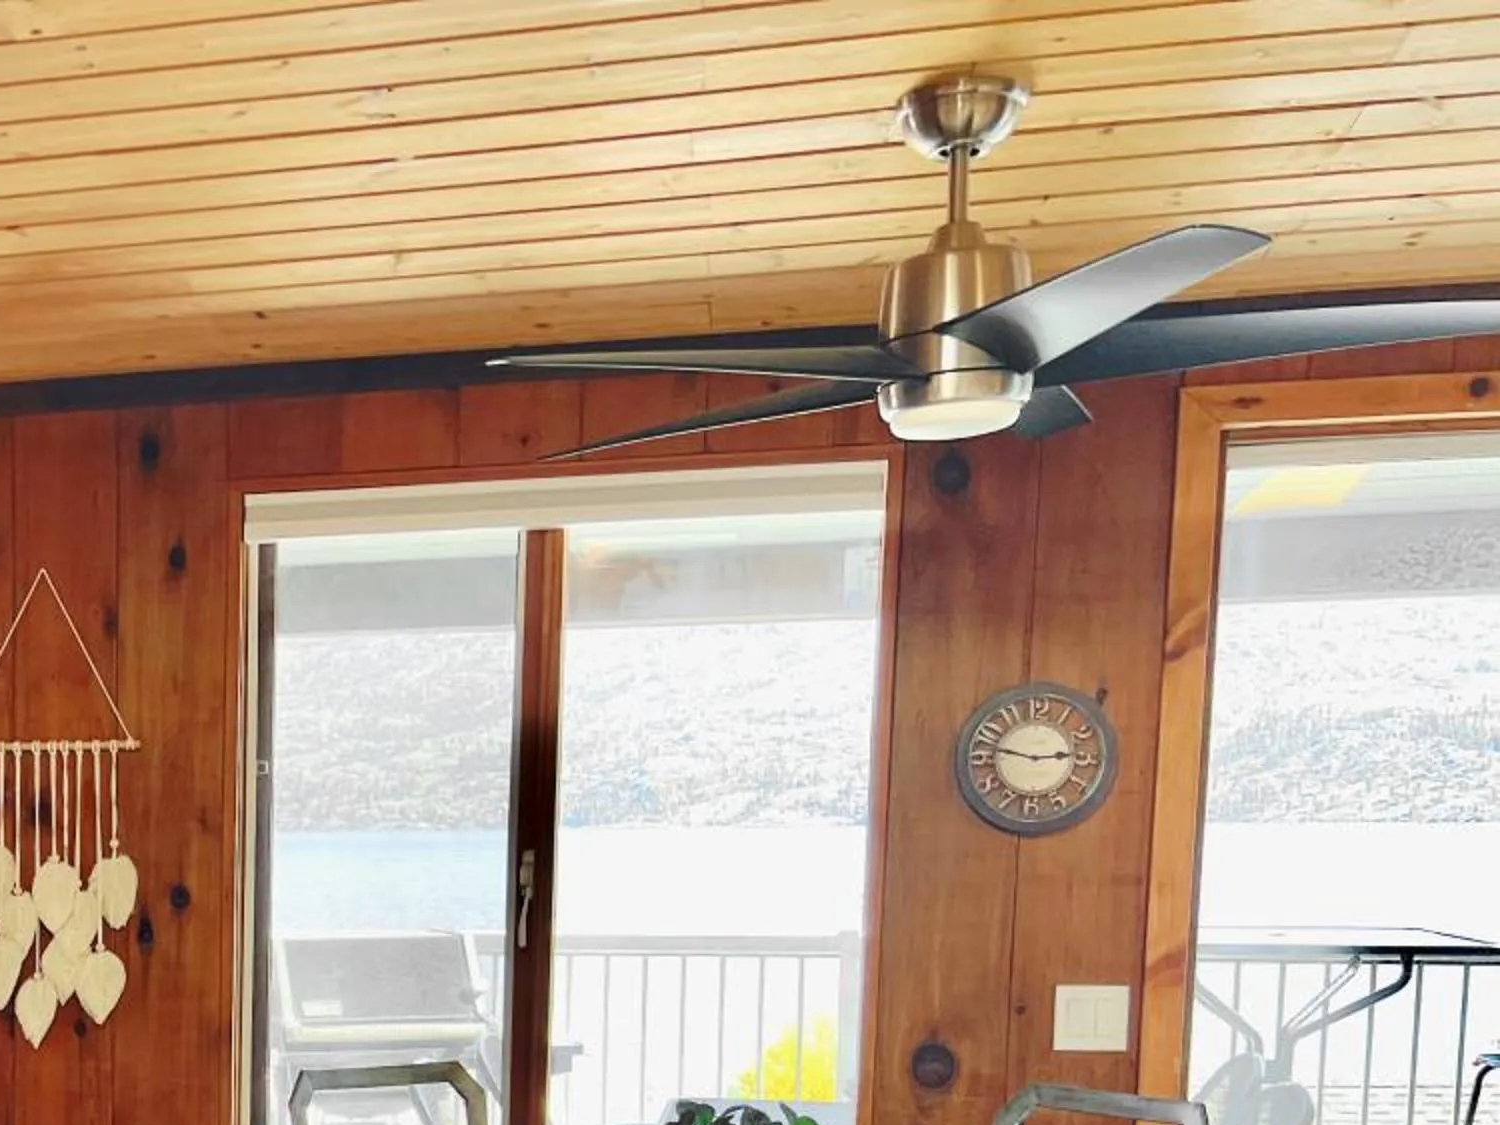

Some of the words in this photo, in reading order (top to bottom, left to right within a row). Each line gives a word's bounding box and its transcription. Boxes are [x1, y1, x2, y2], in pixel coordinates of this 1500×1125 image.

[1001, 703, 1021, 725] 11
[1030, 696, 1049, 720] 12
[1059, 706, 1073, 725] 1
[975, 722, 1002, 745] 10
[1071, 724, 1093, 739] 2
[1075, 751, 1098, 767] 3
[977, 774, 999, 794] 8
[998, 790, 1017, 810] 7
[1023, 796, 1039, 816] 6
[1049, 790, 1067, 811] 5
